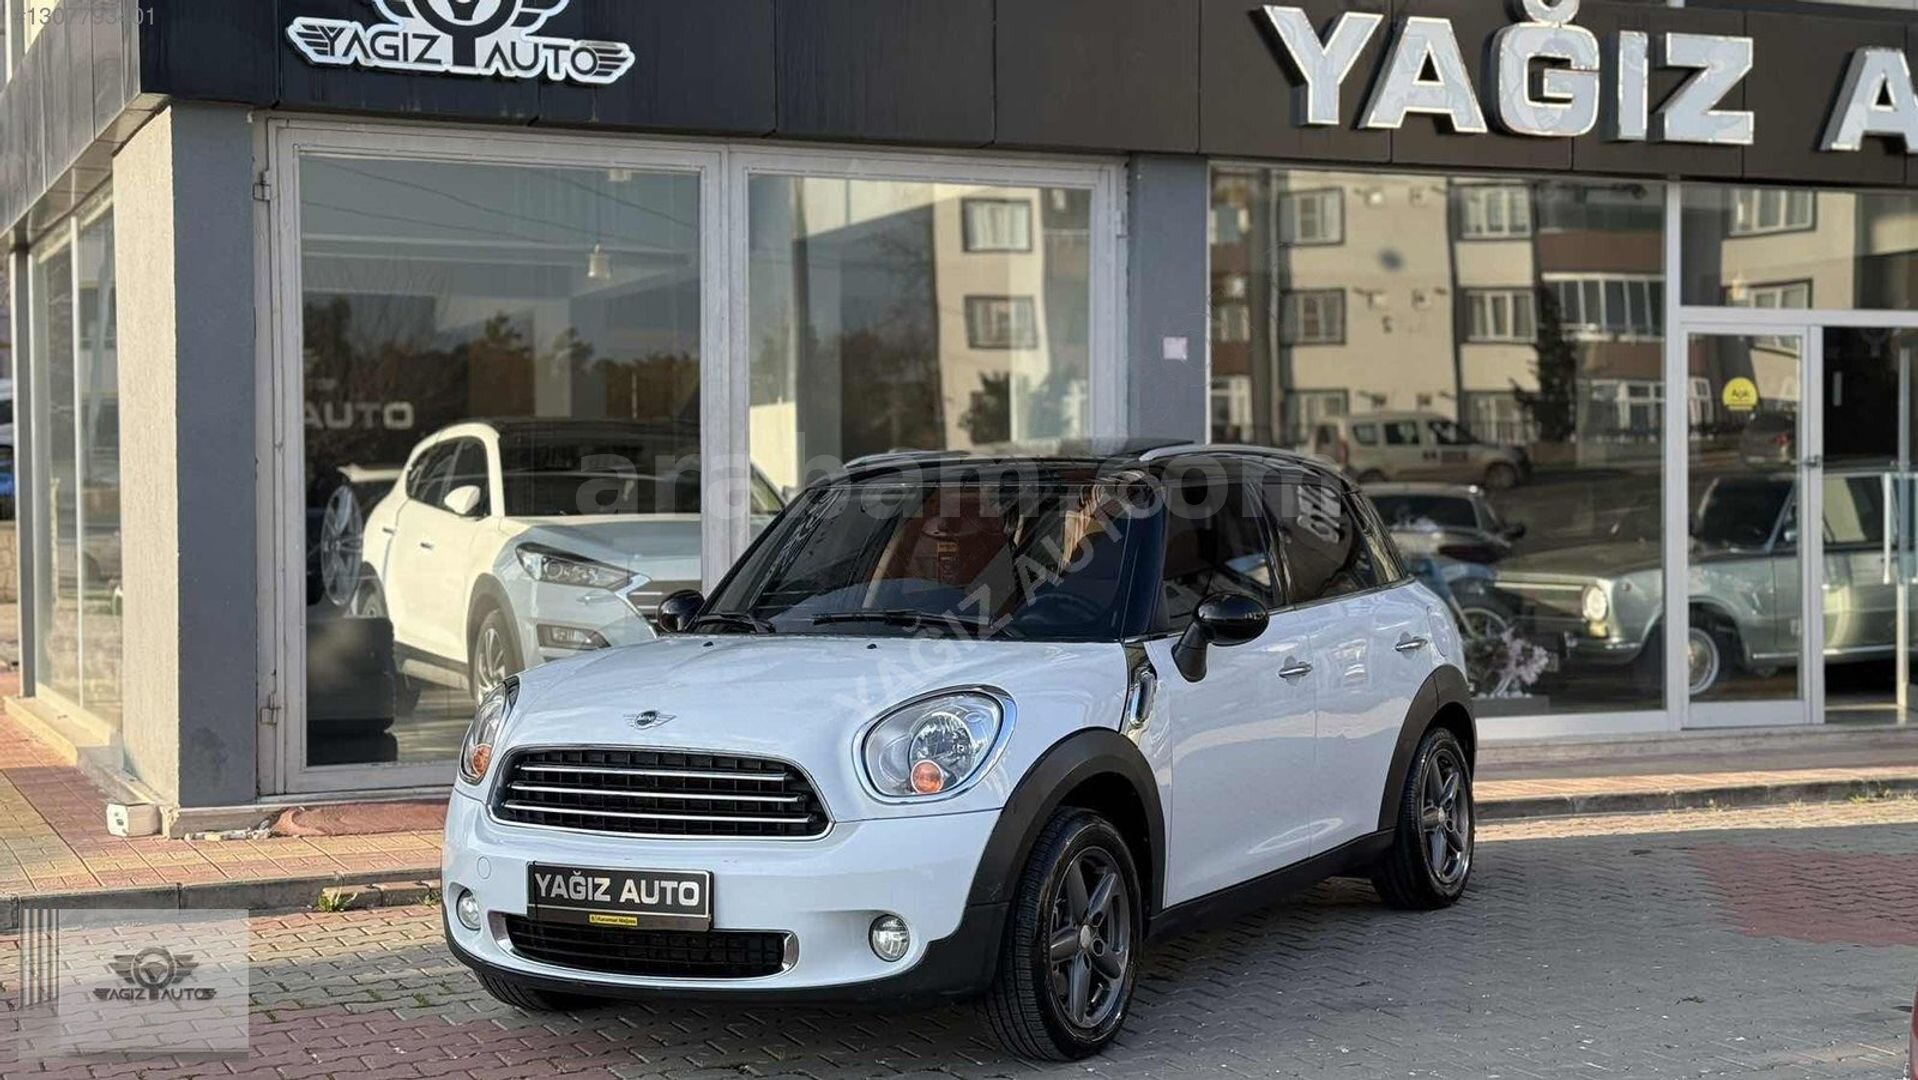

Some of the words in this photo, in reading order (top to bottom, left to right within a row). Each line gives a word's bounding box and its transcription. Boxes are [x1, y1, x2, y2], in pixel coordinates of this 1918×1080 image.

[484, 38, 600, 77] AUTO
[1262, 0, 1755, 146] YAĞIZ
[303, 400, 415, 430] AUTO
[535, 871, 611, 902] YAĞIZ
[619, 879, 700, 907] AUTO
